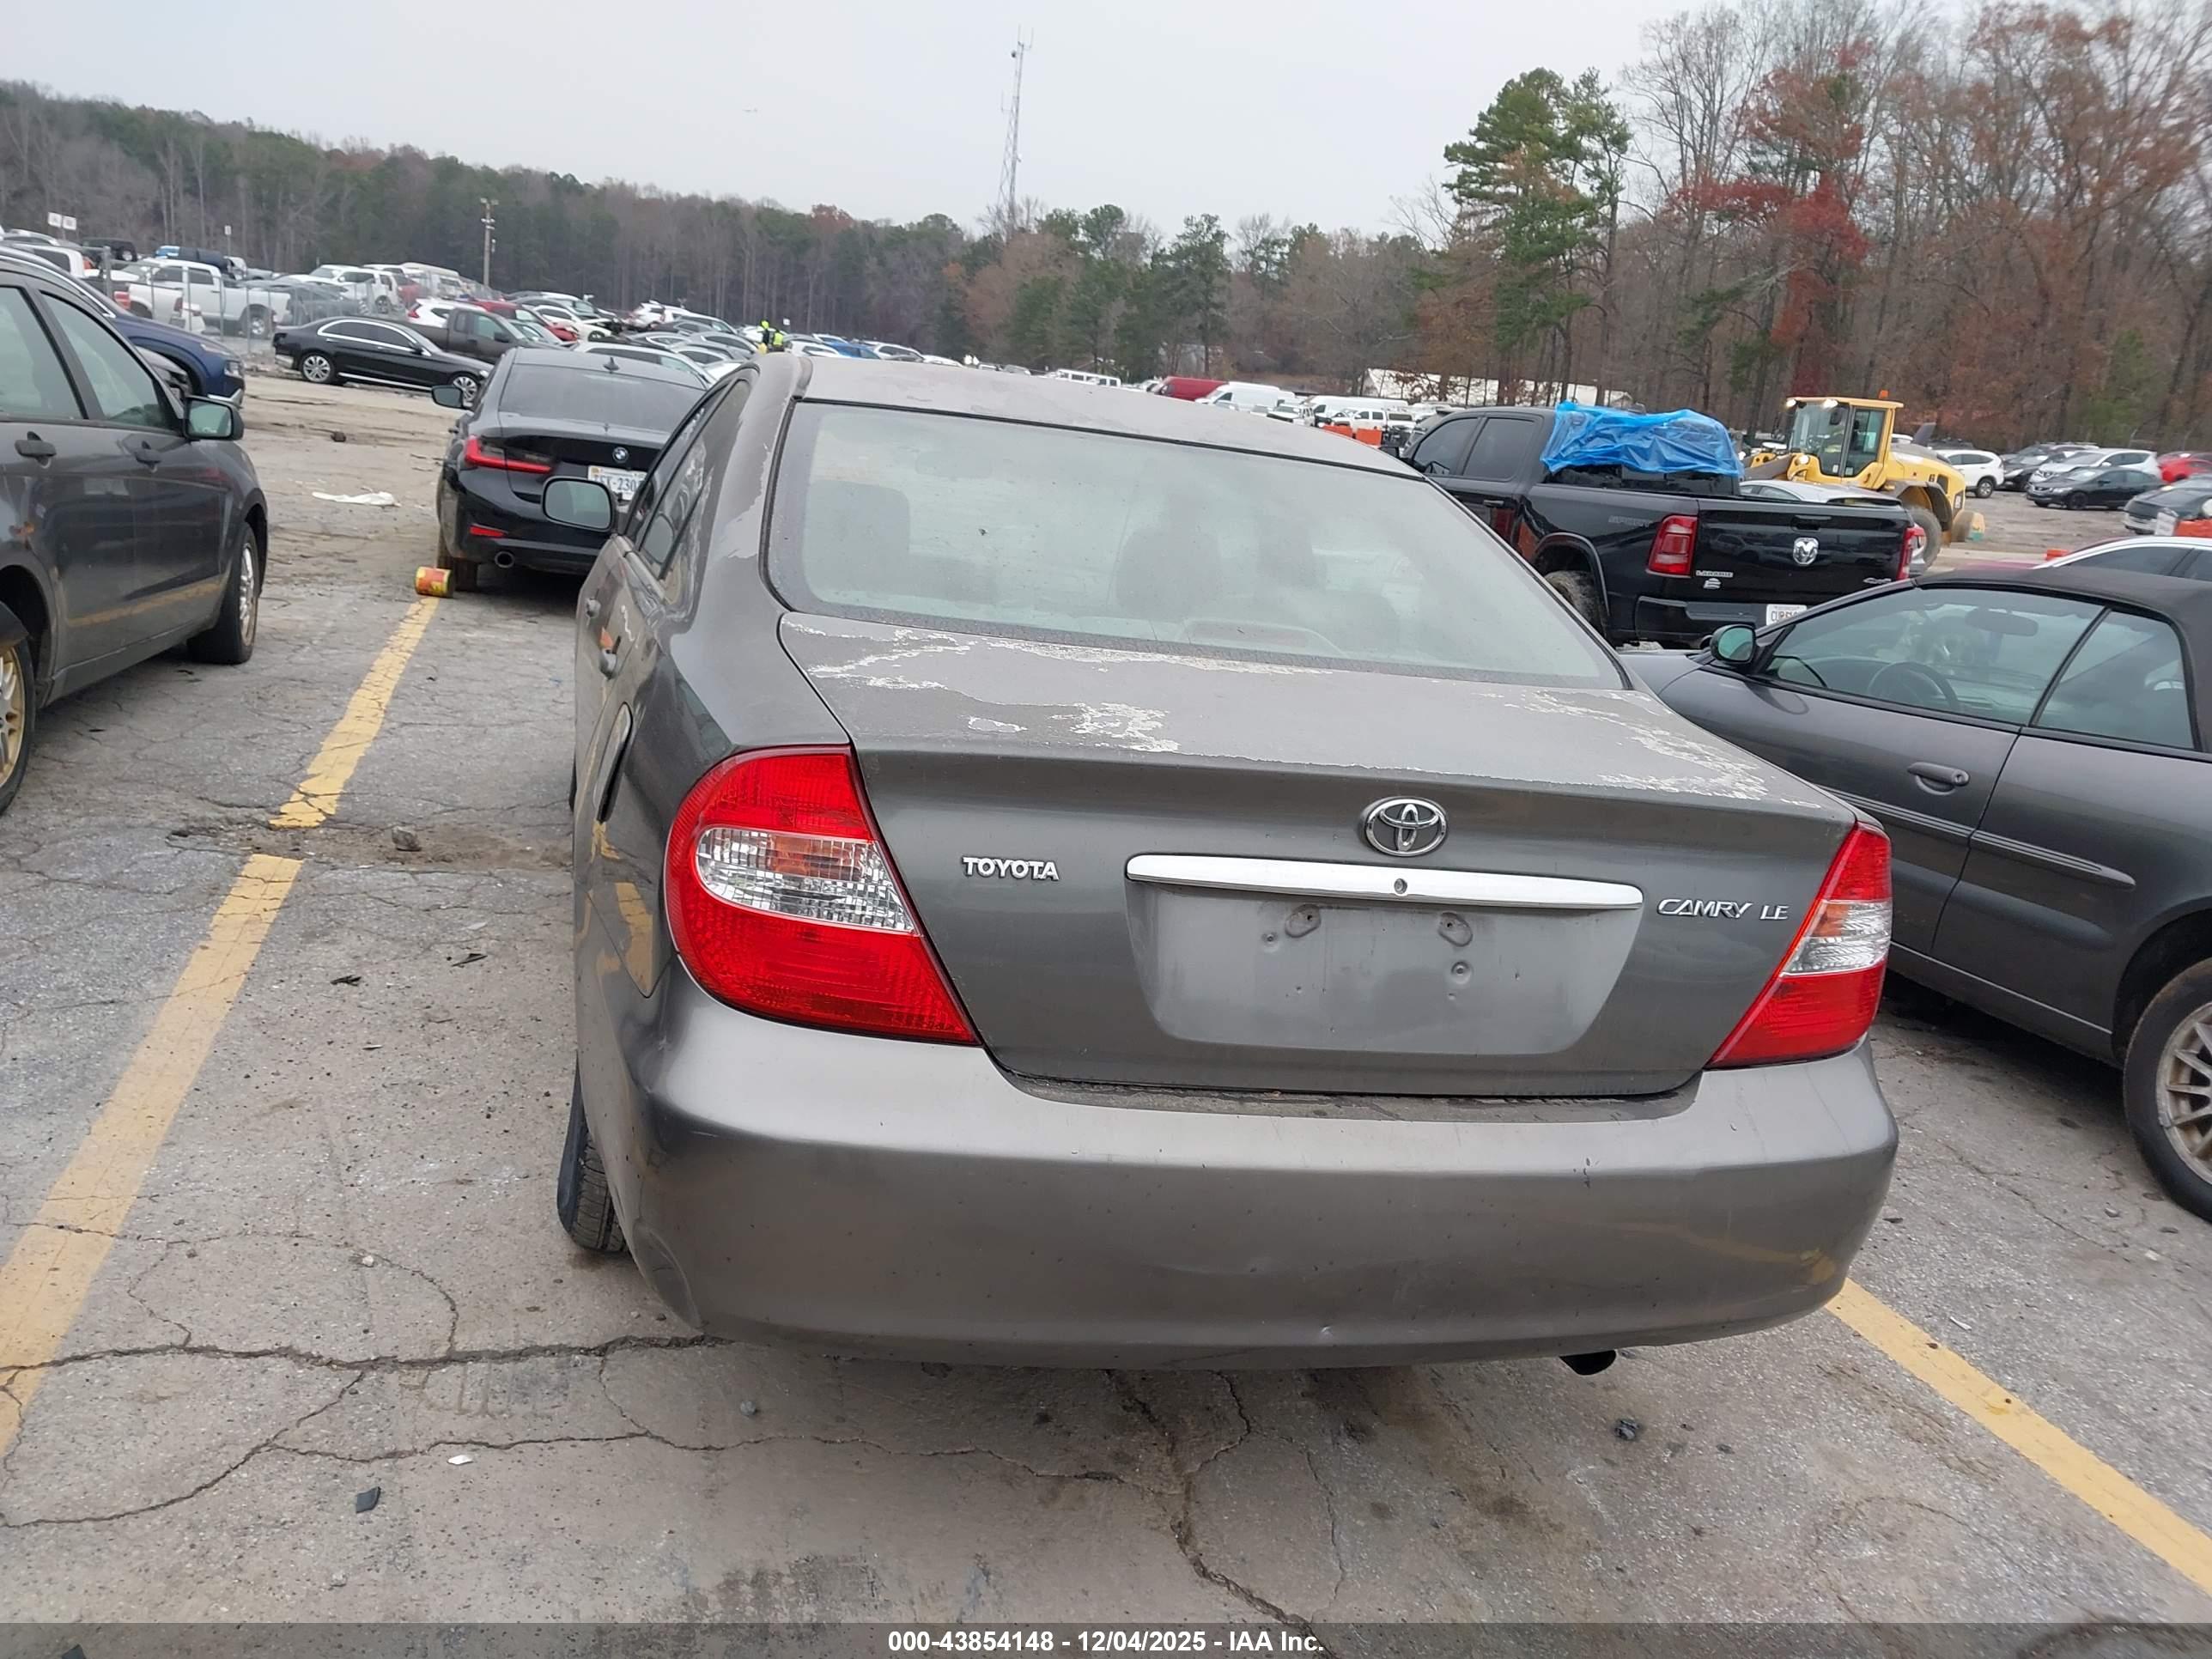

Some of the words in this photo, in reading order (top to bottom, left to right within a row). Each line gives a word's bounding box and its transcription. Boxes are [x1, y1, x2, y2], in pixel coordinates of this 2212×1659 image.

[962, 857, 1060, 881] TOYOTA
[1657, 898, 1753, 920] CAMRY
[1760, 905, 1790, 921] LE
